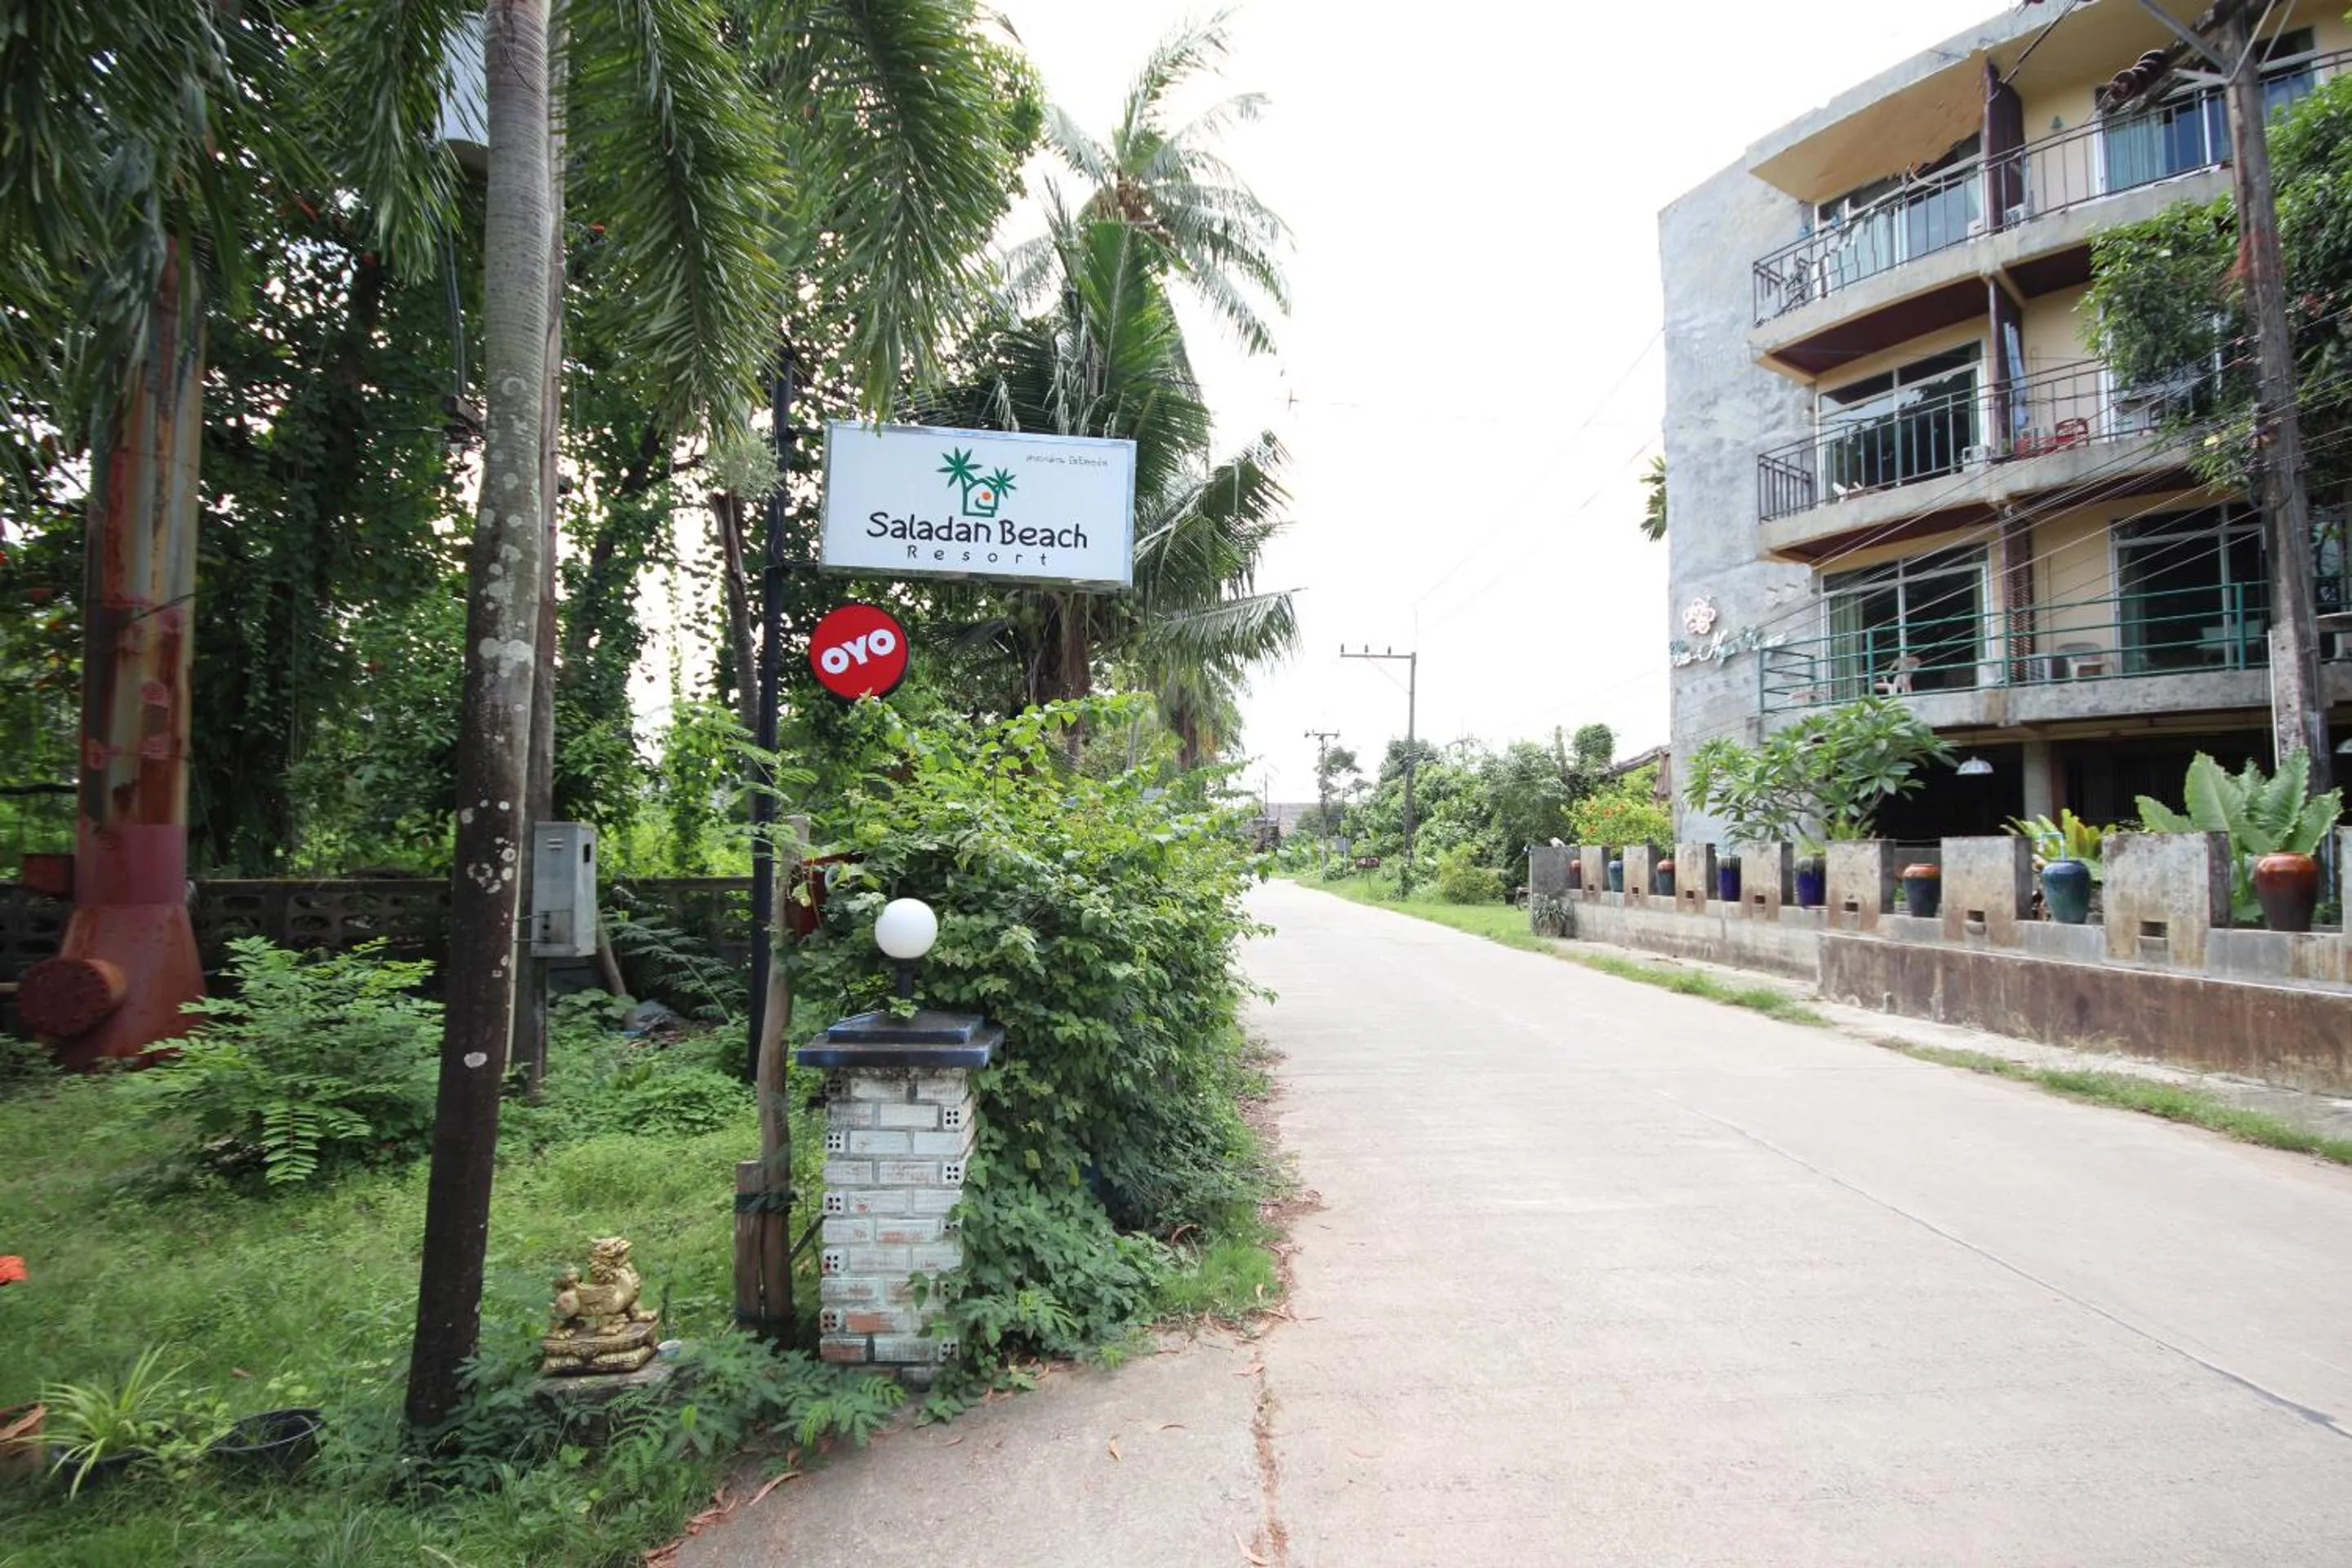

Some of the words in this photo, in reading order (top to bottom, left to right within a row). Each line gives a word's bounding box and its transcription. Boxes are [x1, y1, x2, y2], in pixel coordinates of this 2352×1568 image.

[866, 511, 991, 543] Saladan
[998, 519, 1088, 550] Beach
[906, 545, 1047, 566] Resort
[821, 628, 896, 675] OYO
